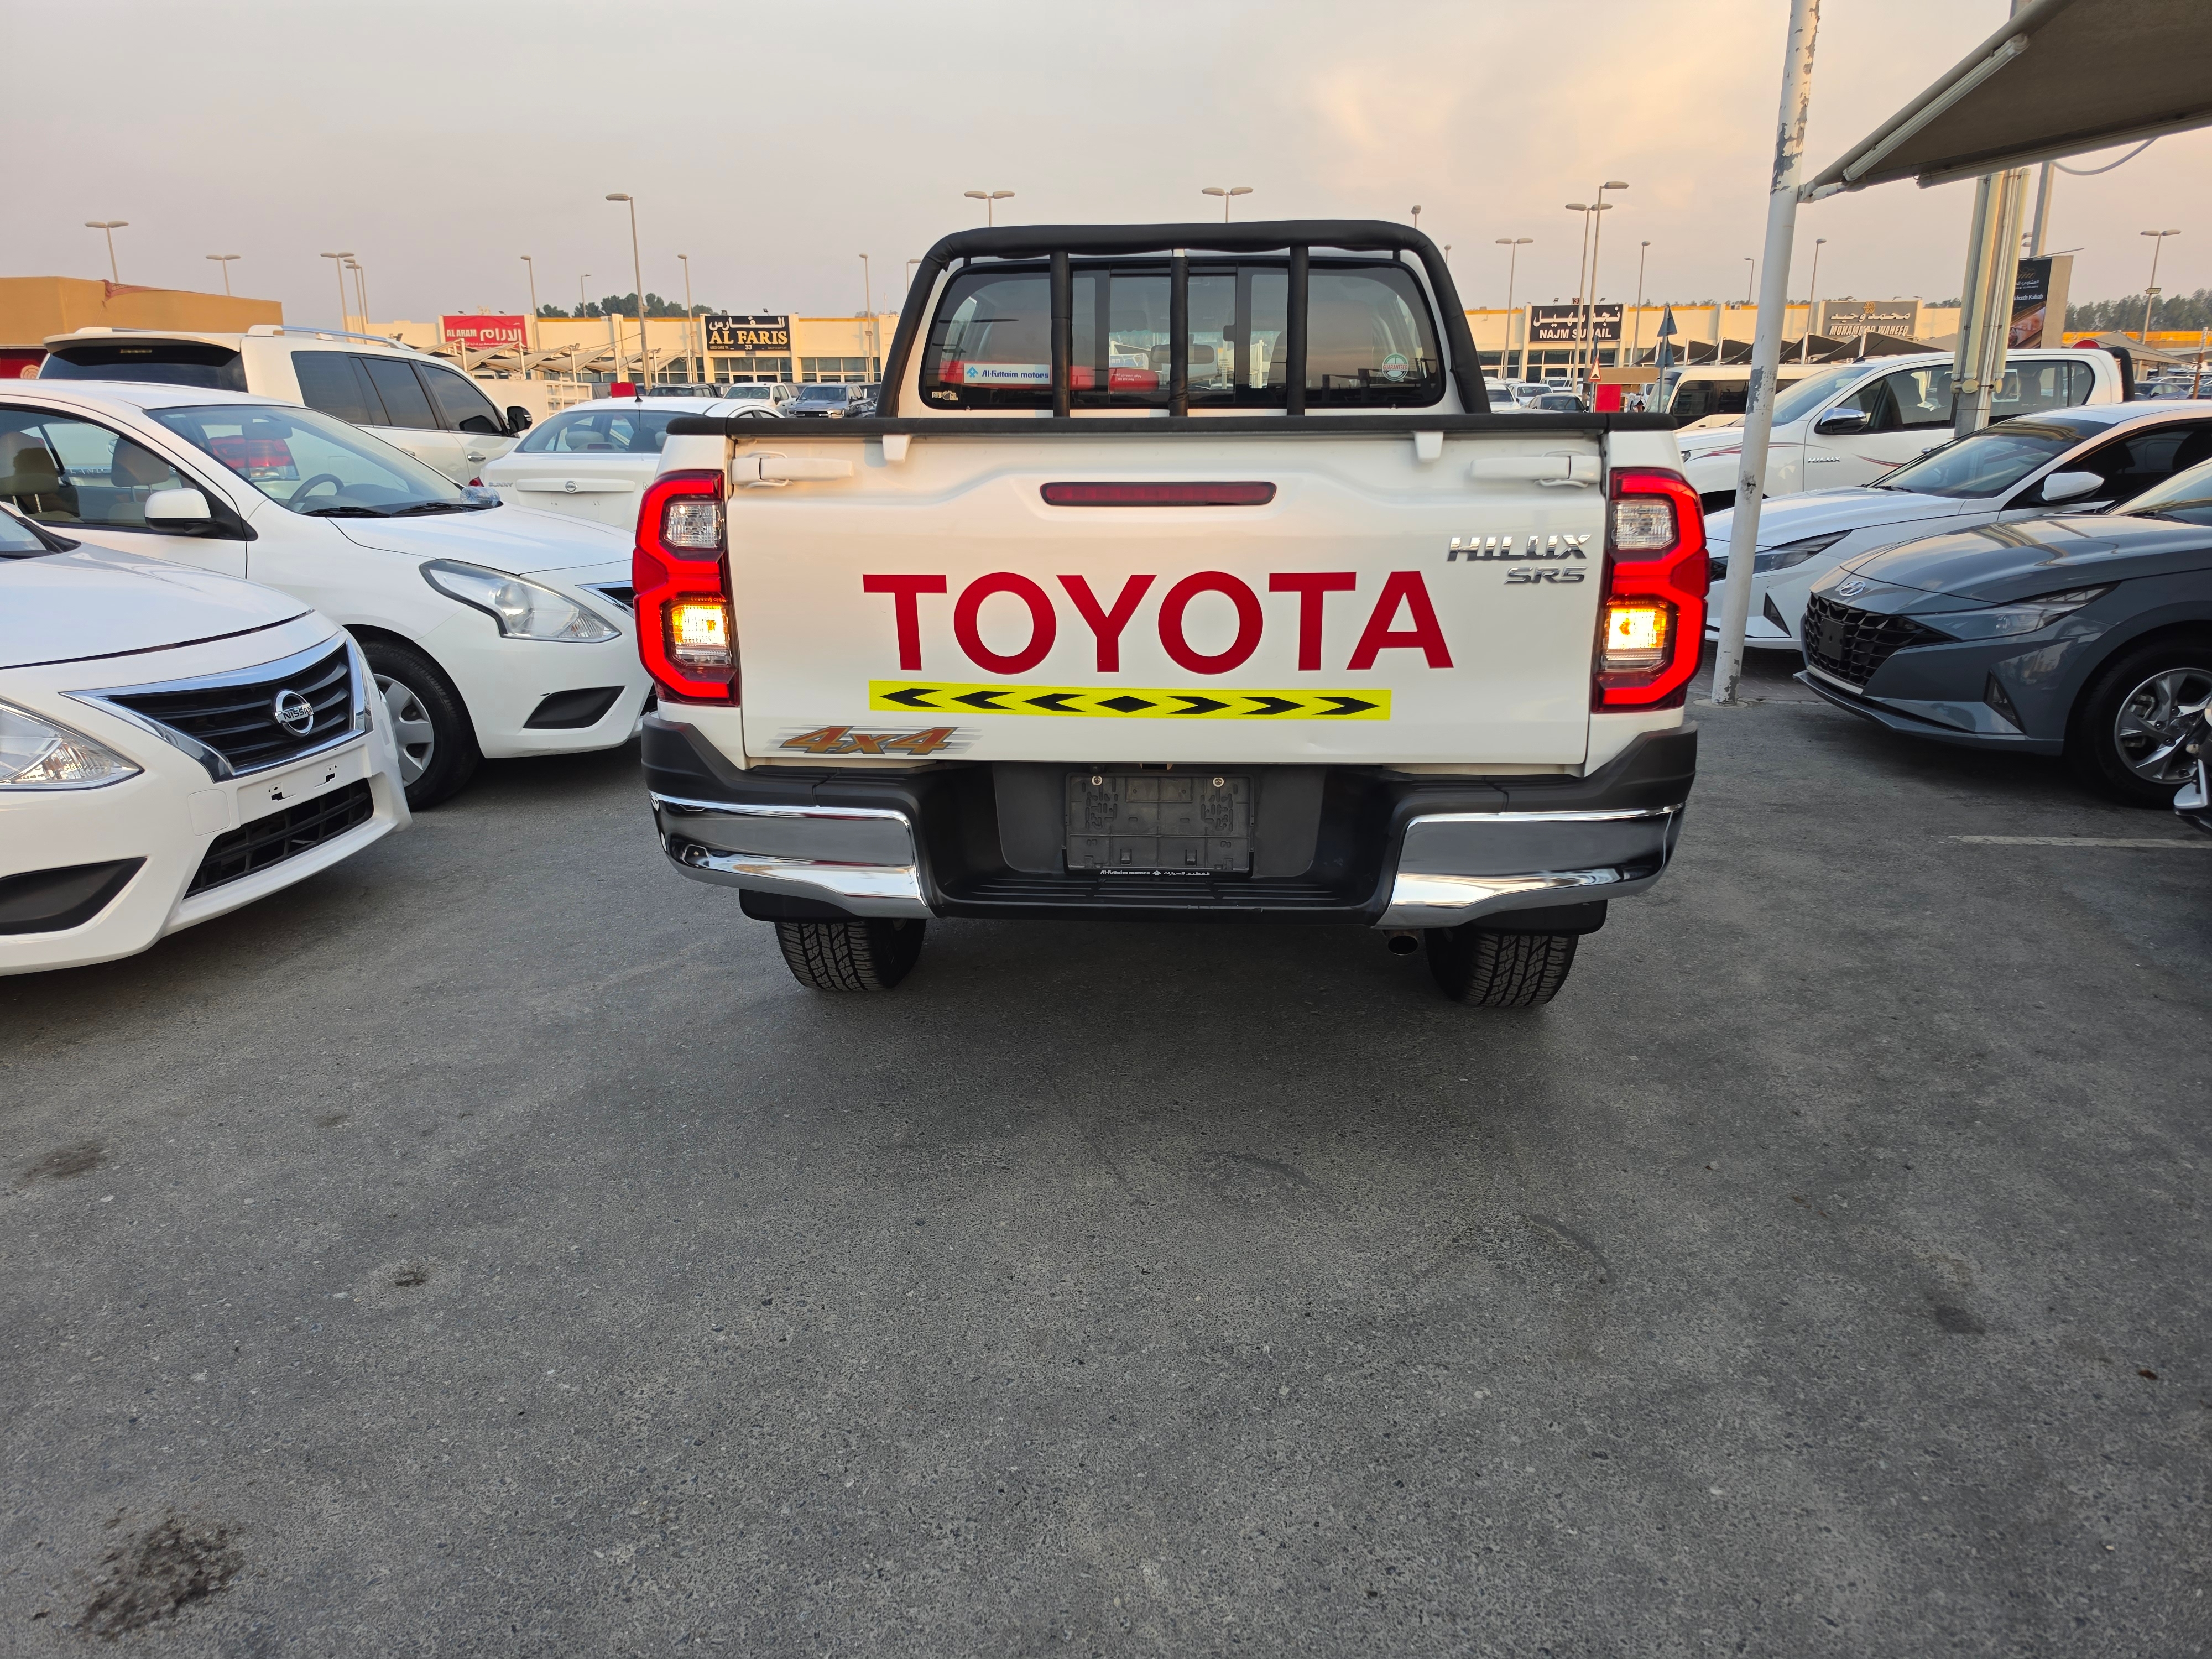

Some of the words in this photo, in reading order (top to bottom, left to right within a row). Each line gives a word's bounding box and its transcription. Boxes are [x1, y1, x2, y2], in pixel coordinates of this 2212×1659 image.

[709, 316, 785, 331] الفارس
[1830, 312, 1866, 323] وحيد
[1539, 329, 1569, 339] NAJM
[1572, 328, 1611, 338] SUAIL
[1878, 325, 1909, 335] WAHEED
[709, 331, 734, 344] AL
[737, 331, 788, 344] FARIS
[982, 369, 1019, 378] Al-Futtaim
[1447, 534, 1592, 561] HILUX
[1504, 566, 1588, 585] SR5
[863, 571, 1454, 675] TOYOTA
[283, 706, 313, 720] NISSAN
[779, 726, 959, 755] 4x4
